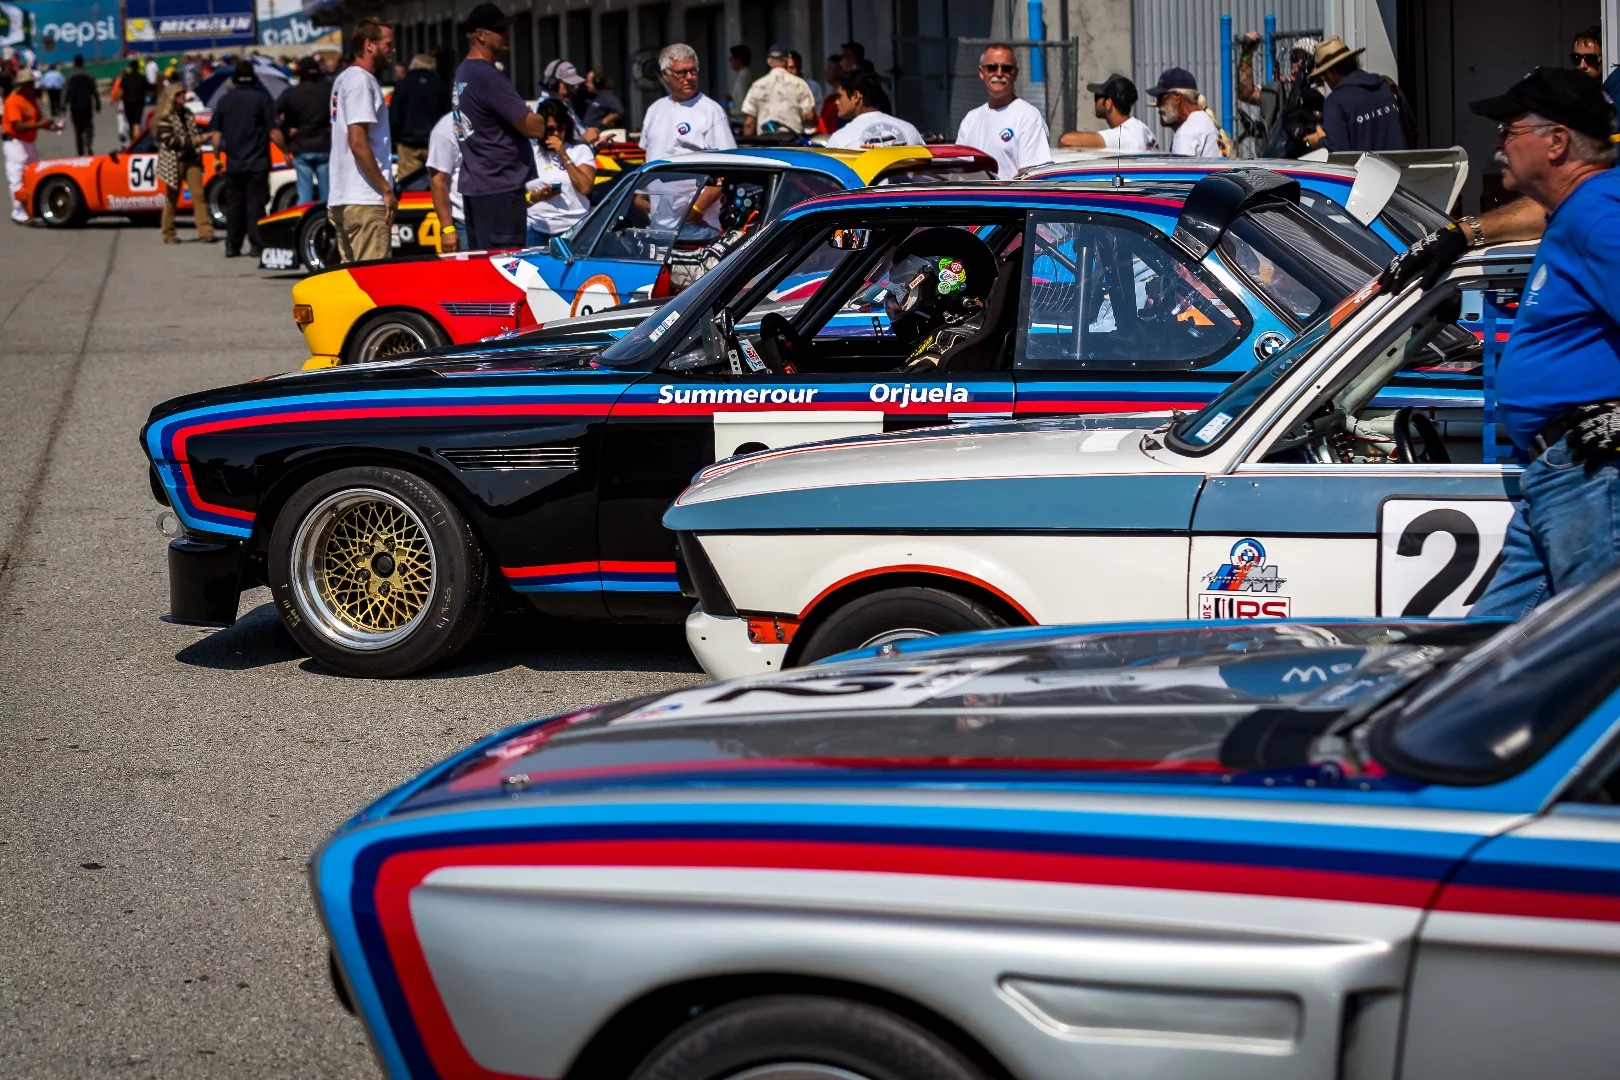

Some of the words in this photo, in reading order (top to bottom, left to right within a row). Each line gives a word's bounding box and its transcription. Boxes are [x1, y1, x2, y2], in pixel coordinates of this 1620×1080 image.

[159, 16, 251, 32] MICHELIN
[131, 157, 156, 188] 54
[658, 385, 818, 404] Summerour
[869, 383, 968, 408] Orjuela
